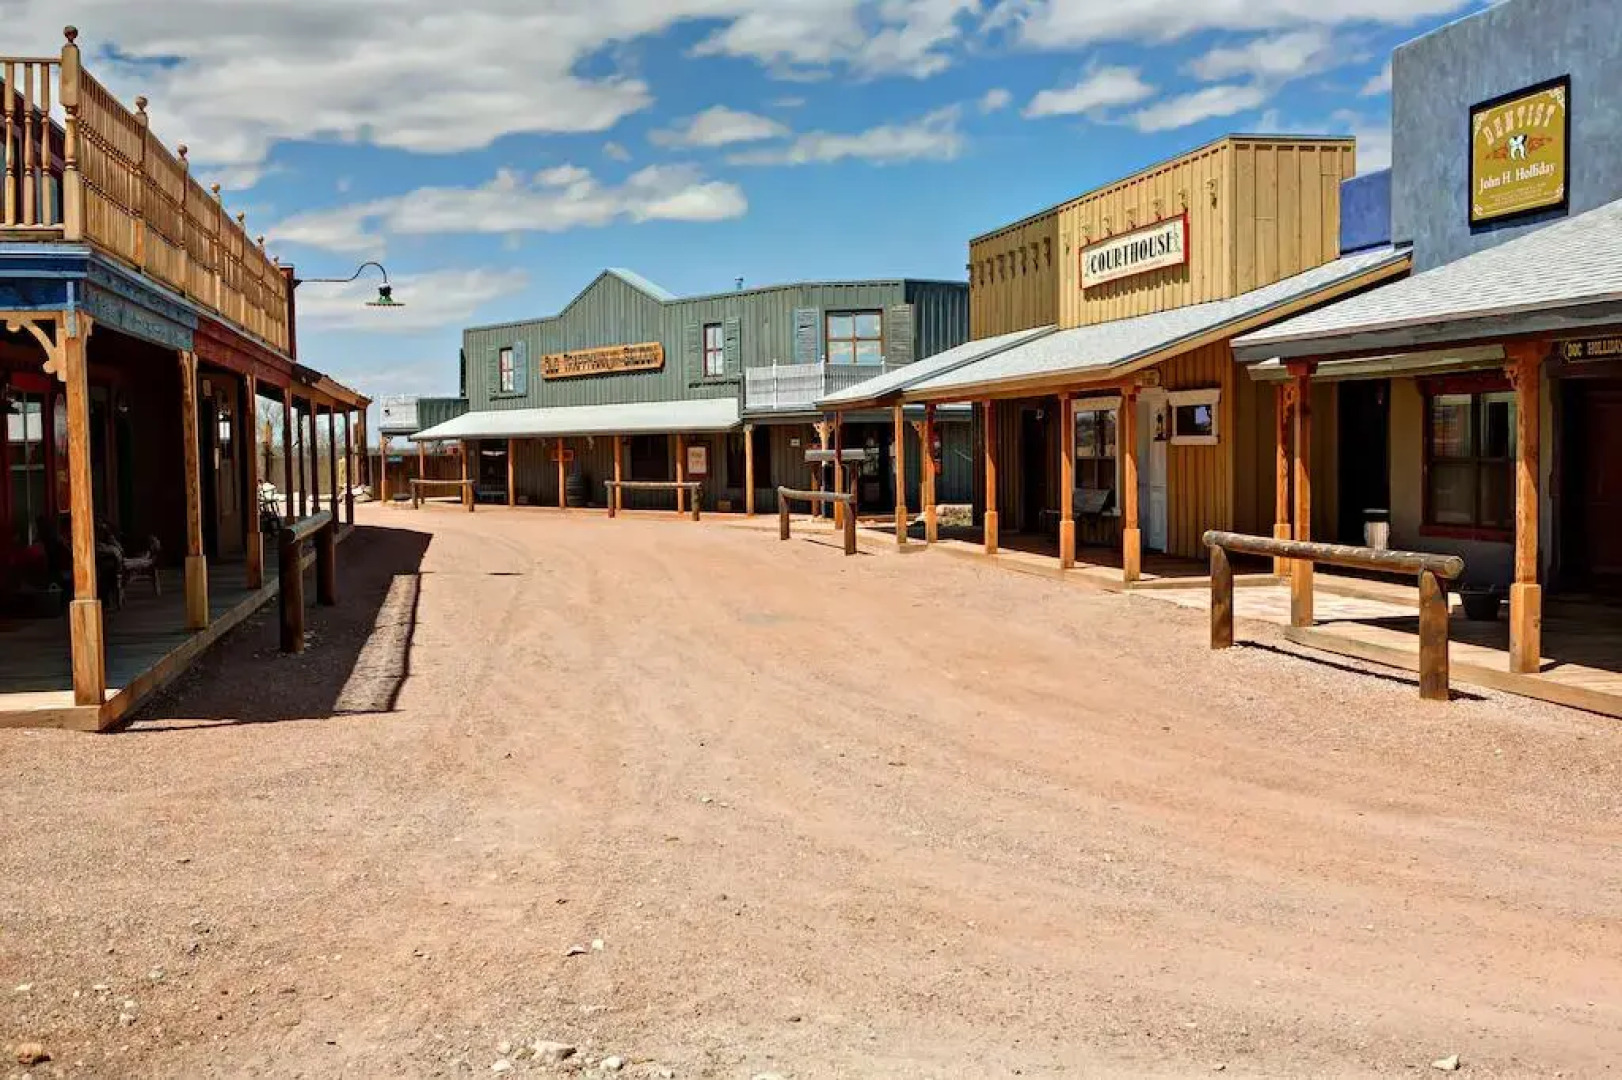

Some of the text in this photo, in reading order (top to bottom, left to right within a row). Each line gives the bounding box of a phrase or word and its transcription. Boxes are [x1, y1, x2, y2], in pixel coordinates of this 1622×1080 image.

[1482, 103, 1556, 146] DENTIST
[1478, 176, 1501, 196] John
[1515, 161, 1556, 182] Holliday
[1090, 230, 1176, 275] COURTHOUSE
[1567, 342, 1583, 357] DOC
